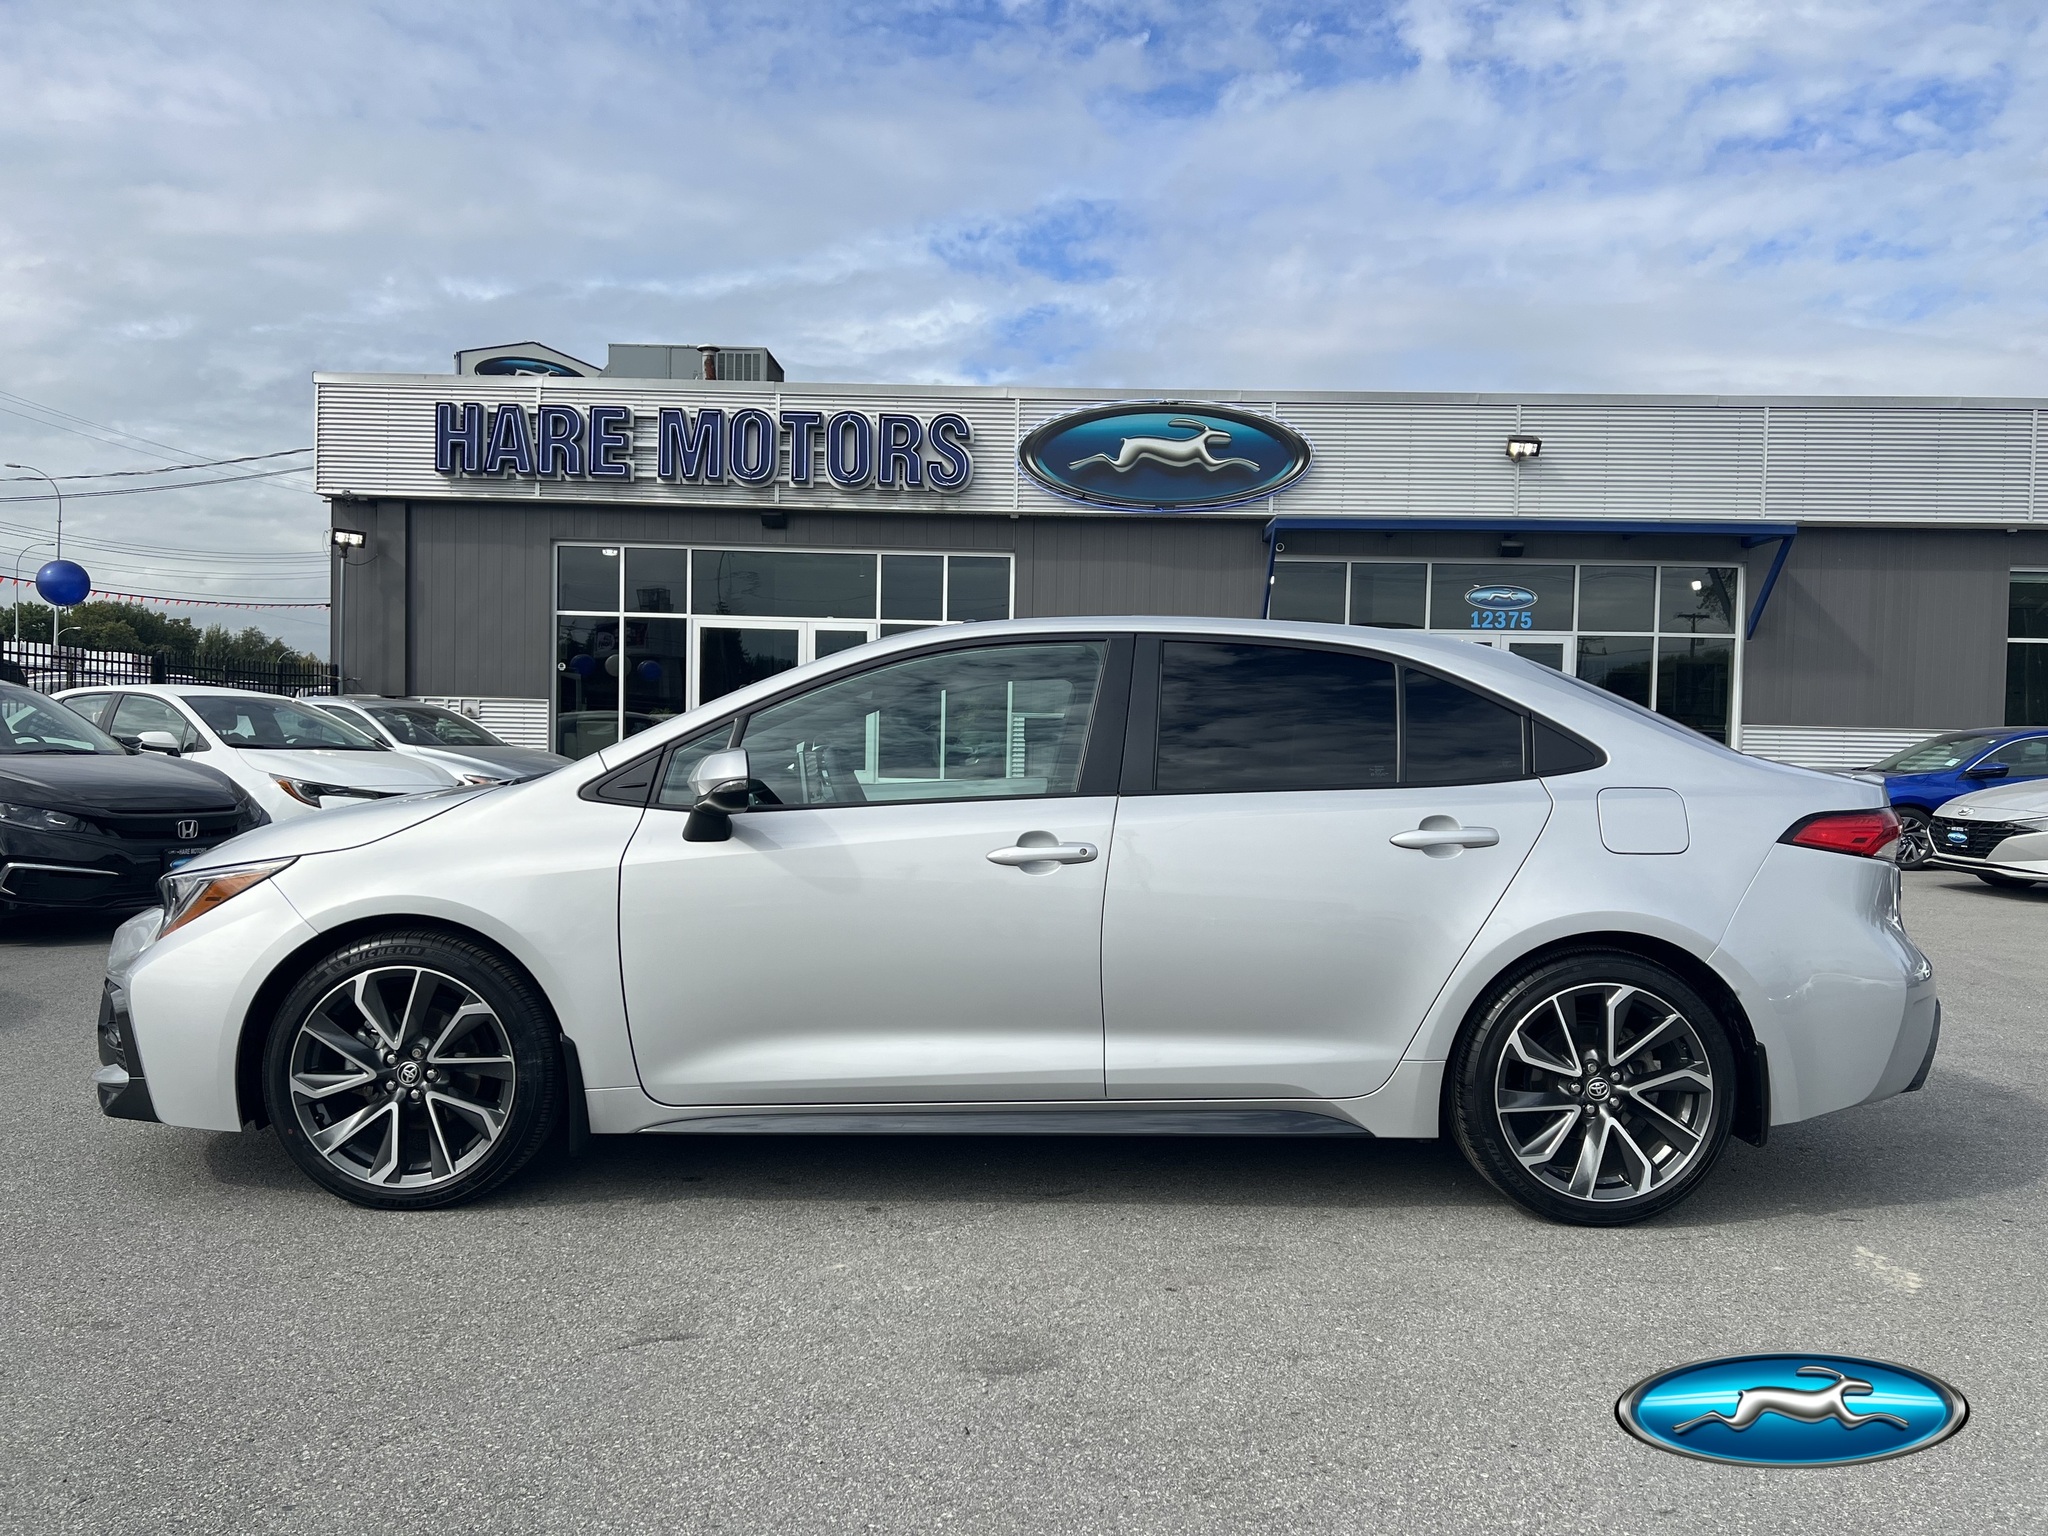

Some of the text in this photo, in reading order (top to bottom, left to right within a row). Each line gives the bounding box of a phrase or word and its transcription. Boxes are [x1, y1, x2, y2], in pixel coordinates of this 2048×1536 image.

[435, 401, 974, 493] HARE MOTORS
[1470, 610, 1533, 630] 12375
[350, 946, 421, 963] MICHELIN
[1486, 1141, 1536, 1197] MICHELIN
